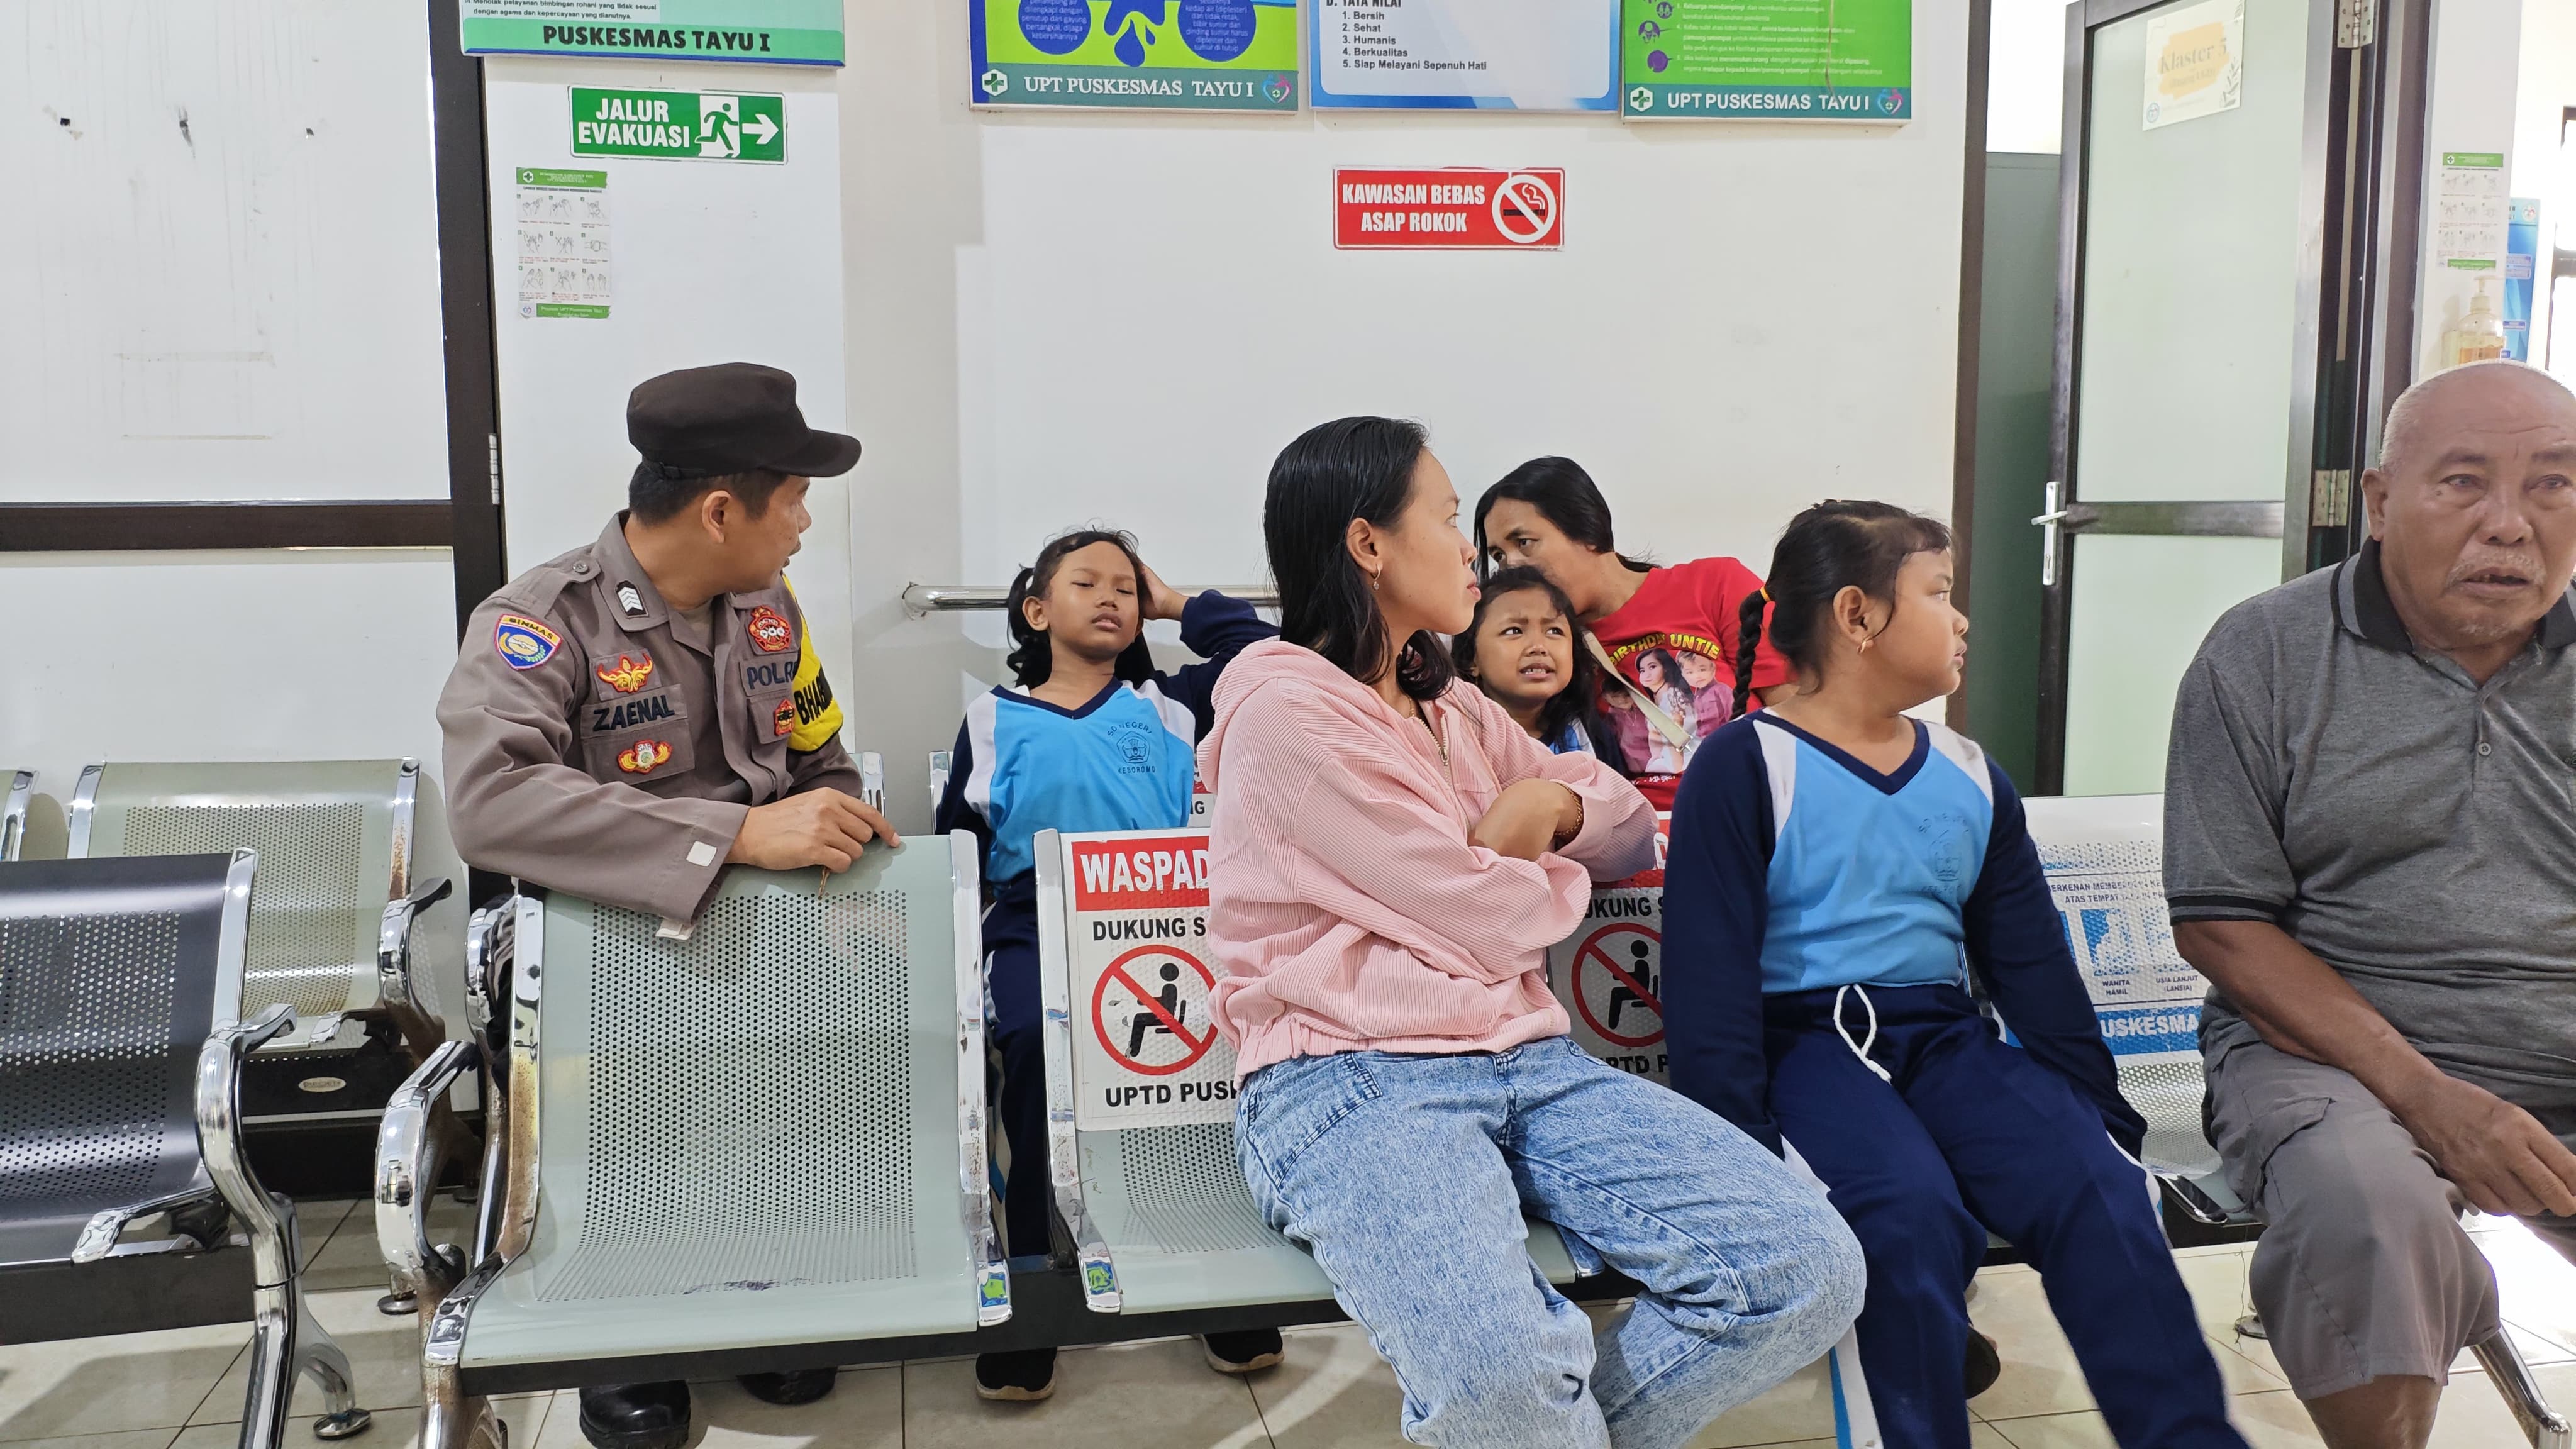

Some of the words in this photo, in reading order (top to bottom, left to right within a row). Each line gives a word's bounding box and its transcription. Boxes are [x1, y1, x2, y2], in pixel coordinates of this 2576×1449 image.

[1342, 11, 1350, 19] 1.
[1353, 11, 1385, 20] Bersih
[1342, 23, 1350, 32] 2.
[1353, 23, 1381, 32] Sehat
[543, 25, 686, 48] PUSKESMAS
[692, 31, 754, 51] TAYU
[759, 33, 770, 52] I
[1342, 35, 1351, 44] 3.
[1353, 36, 1396, 45] Humanis
[1342, 48, 1352, 57] 4.
[1354, 48, 1408, 57] Berkualitas
[1343, 60, 1352, 69] 5.
[1354, 60, 1375, 70] Siap
[1379, 61, 1420, 71] Melayani
[1423, 62, 1465, 71] Sepenuh
[1468, 62, 1487, 70] Hati
[1024, 76, 1062, 92] UPT
[1067, 77, 1182, 96] PUSKESMAS
[1191, 80, 1241, 97] TAYU
[1246, 82, 1253, 97] I
[596, 98, 669, 123] JALUR
[1668, 92, 1702, 109] UPT
[1706, 93, 1811, 110] PUSKESMAS
[1819, 94, 1861, 110] TAYU
[1865, 96, 1869, 110] I
[578, 123, 684, 148] EVAKUASI
[1342, 184, 1426, 204] KAWASAN
[1431, 185, 1485, 205] BEBAS
[1361, 212, 1406, 232] ASAP
[1409, 213, 1467, 232] ROKOK
[509, 618, 553, 640] BINMAS
[1670, 633, 1721, 660] UNTIE
[593, 695, 675, 731] ZAENAL
[1107, 726, 1118, 736] SD
[2065, 895, 2085, 904] ATAS
[2088, 894, 2119, 902] TEMPAT
[1092, 918, 1185, 941] DUKUNG
[1105, 1084, 1171, 1108] UPTD
